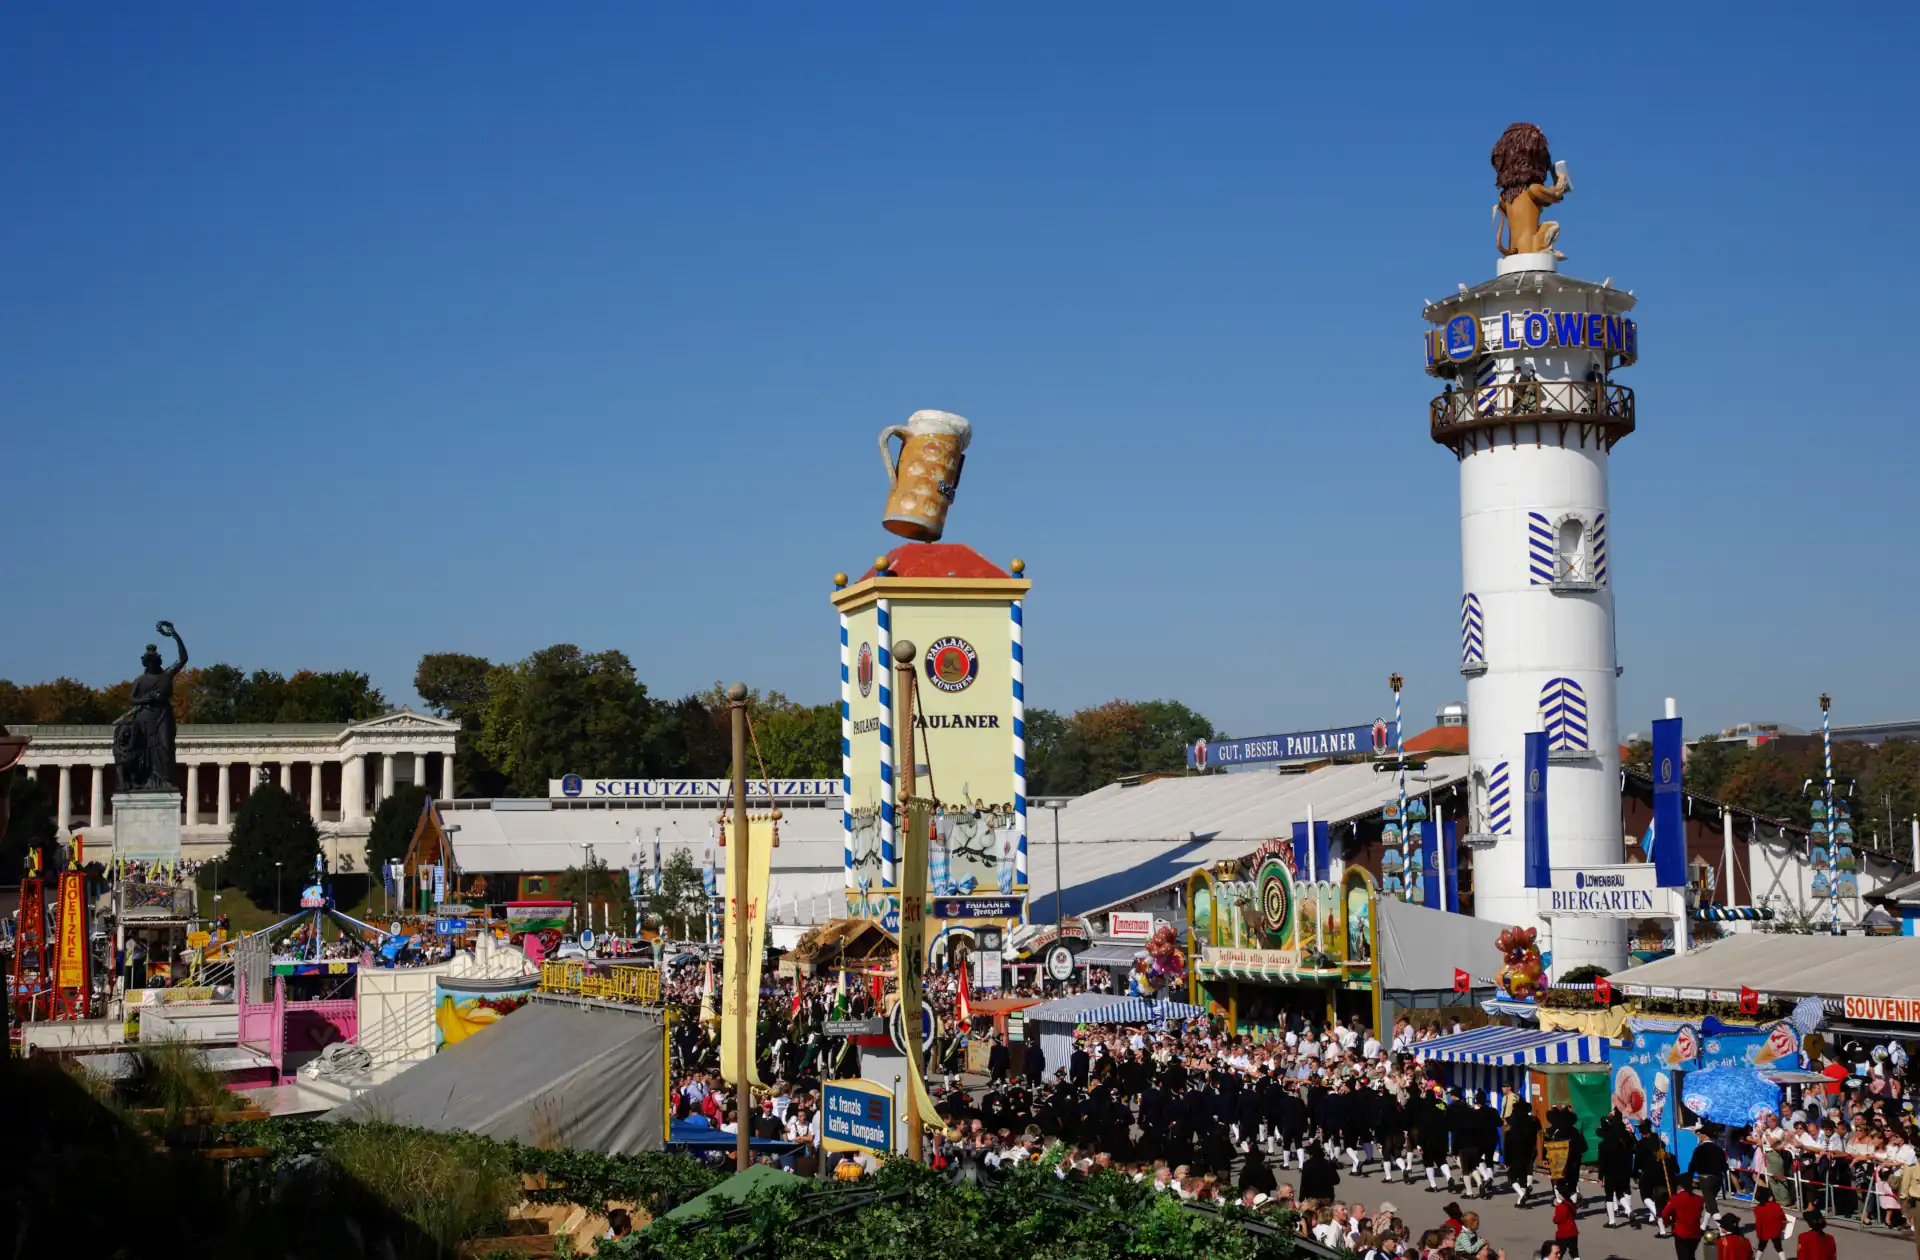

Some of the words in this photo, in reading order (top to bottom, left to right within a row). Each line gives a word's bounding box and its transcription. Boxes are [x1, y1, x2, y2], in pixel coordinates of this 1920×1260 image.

[926, 637, 977, 661] PAULANER
[931, 674, 974, 692] MÜNCHEN
[853, 716, 880, 735] PAULANER
[1219, 744, 1242, 761] GUT,
[1245, 740, 1283, 758] BESSER,
[1287, 733, 1356, 756] PAULANER
[595, 779, 722, 796] SCHÜTZEN
[731, 780, 839, 796] ESTZELT
[1585, 874, 1625, 887] LÖWENBRÄU
[965, 900, 1011, 909] PAULANER
[1552, 890, 1653, 910] BIERGARTEN
[67, 877, 78, 958] GOETZKE
[439, 922, 448, 932] U
[1113, 914, 1150, 935] Zimmermann
[829, 1096, 838, 1110] st.
[839, 1095, 862, 1116] franzls
[828, 1115, 849, 1135] kaffee
[851, 1120, 885, 1144] kompanie
